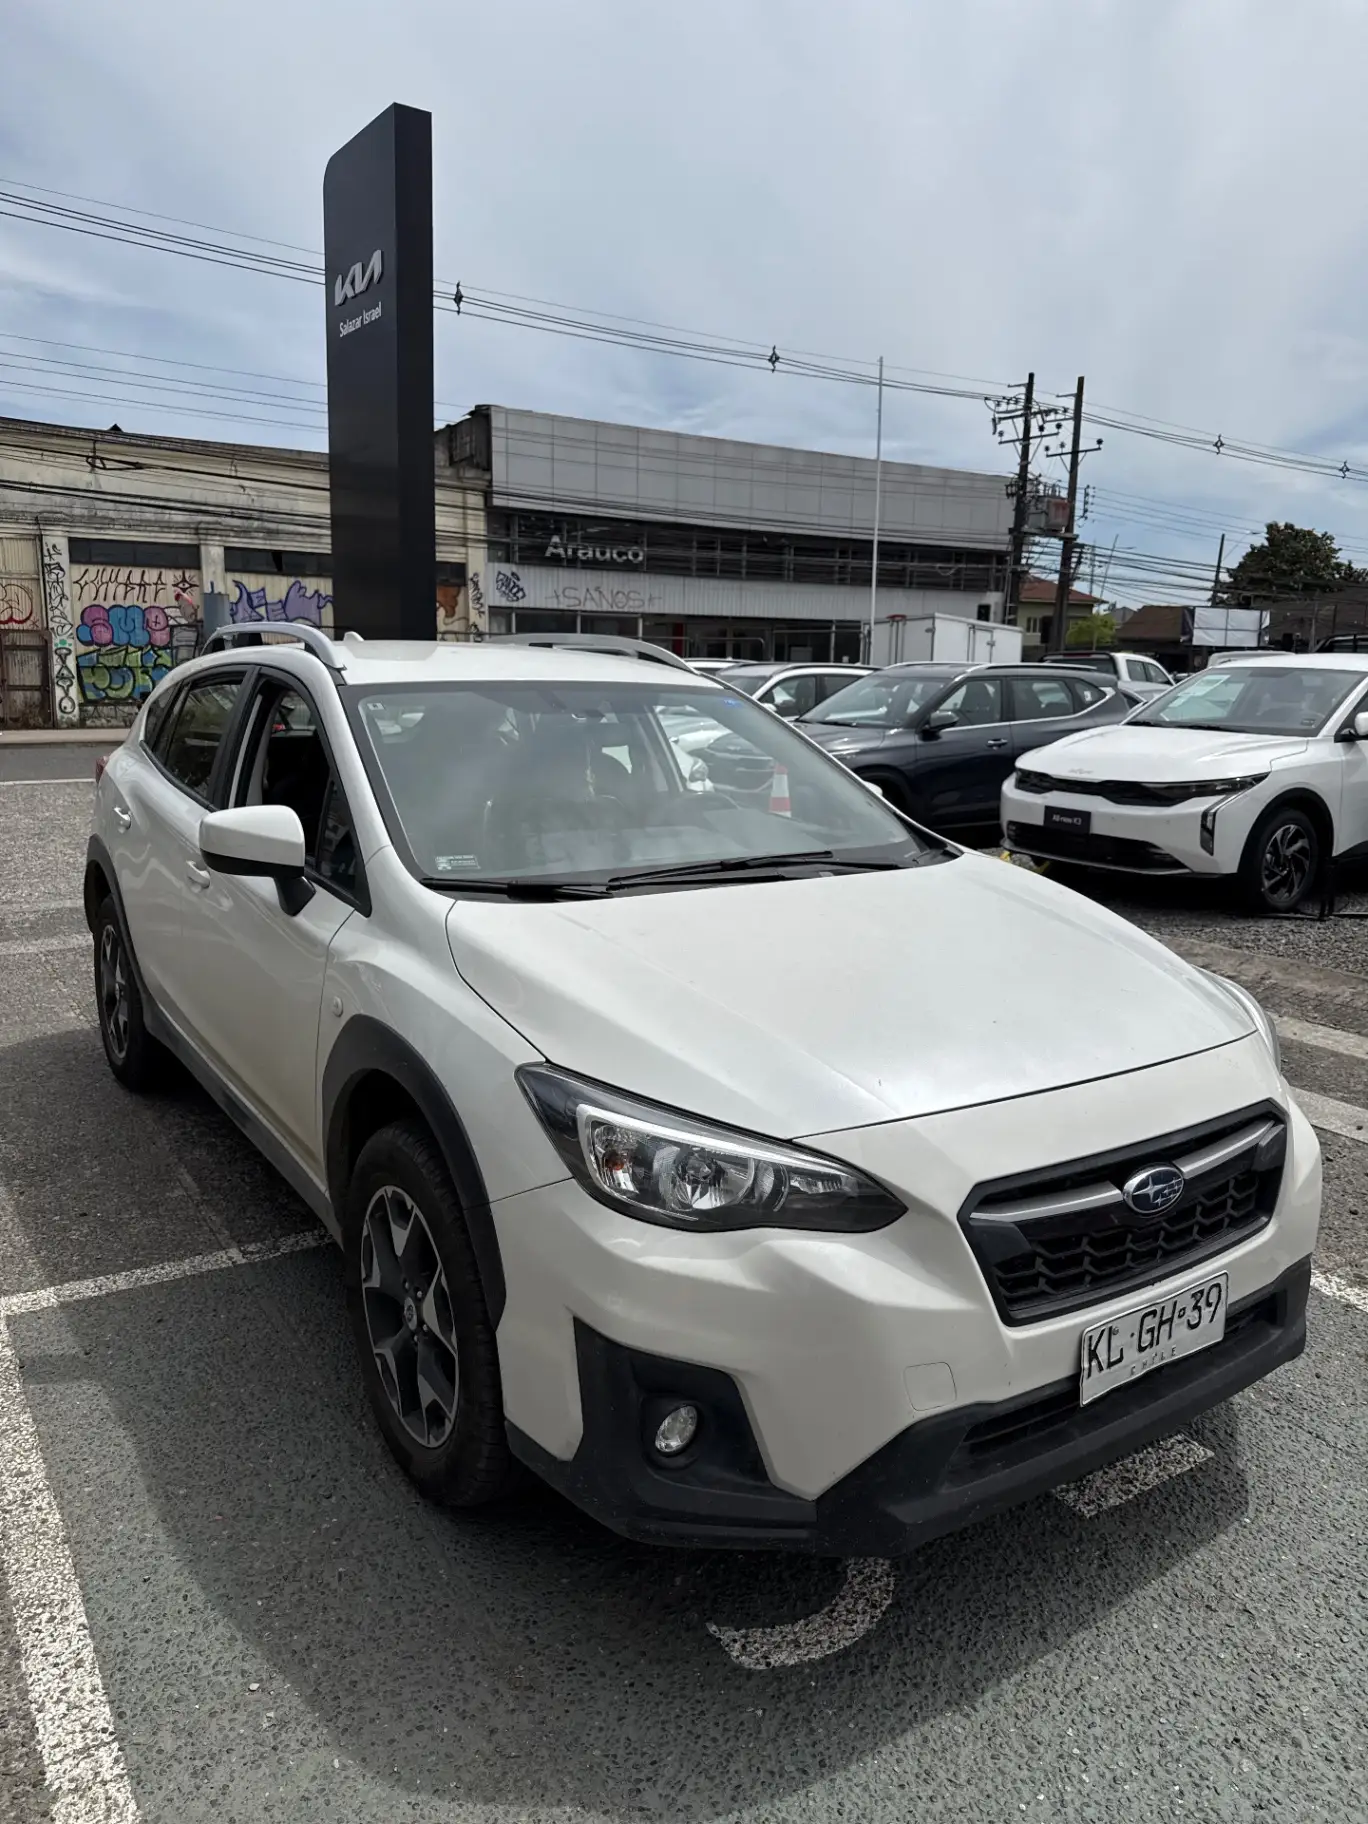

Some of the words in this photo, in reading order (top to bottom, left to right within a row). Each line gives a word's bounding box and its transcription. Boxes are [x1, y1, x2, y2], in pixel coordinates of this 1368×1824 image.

[339, 315, 362, 338] Salazar
[362, 300, 382, 325] Israel
[544, 535, 644, 564] Arauco
